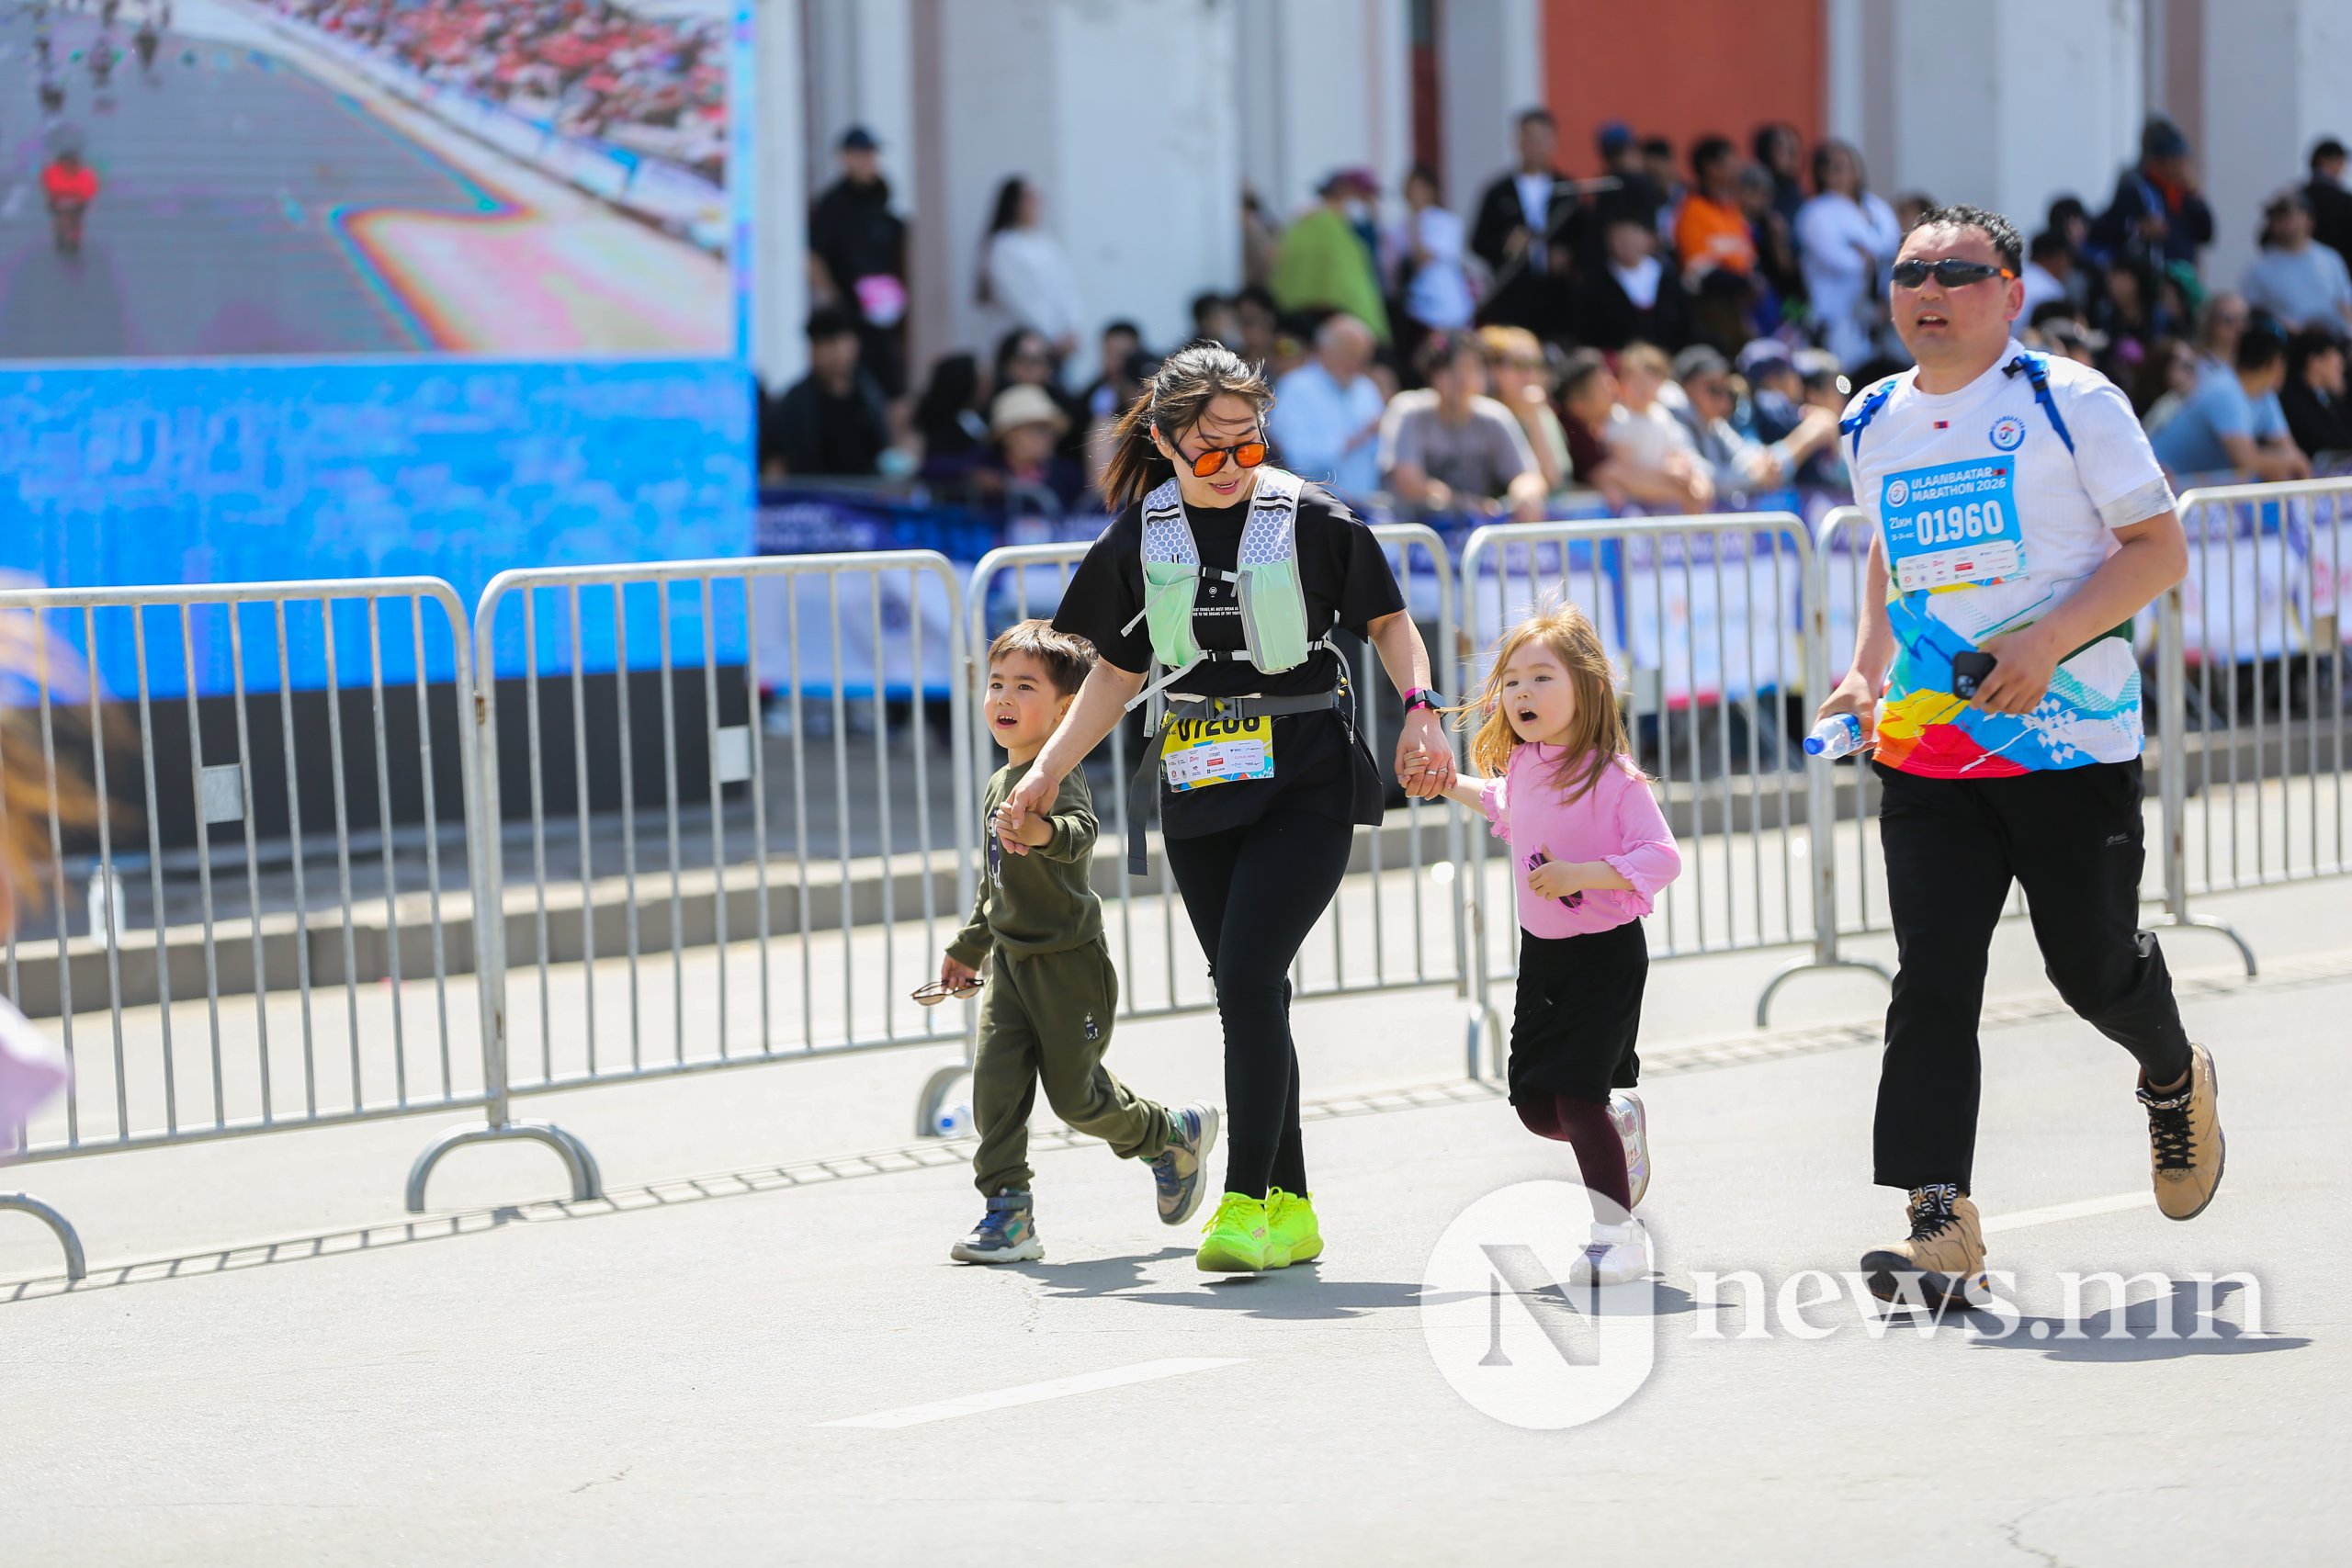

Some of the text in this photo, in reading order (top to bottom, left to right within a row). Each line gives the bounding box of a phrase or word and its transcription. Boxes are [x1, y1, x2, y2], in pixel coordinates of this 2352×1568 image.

[1911, 467, 1993, 490] ULAANBAATAR
[1912, 481, 1974, 502] MARATHON
[1976, 478, 2007, 491] 2026
[1917, 500, 2005, 546] 01960
